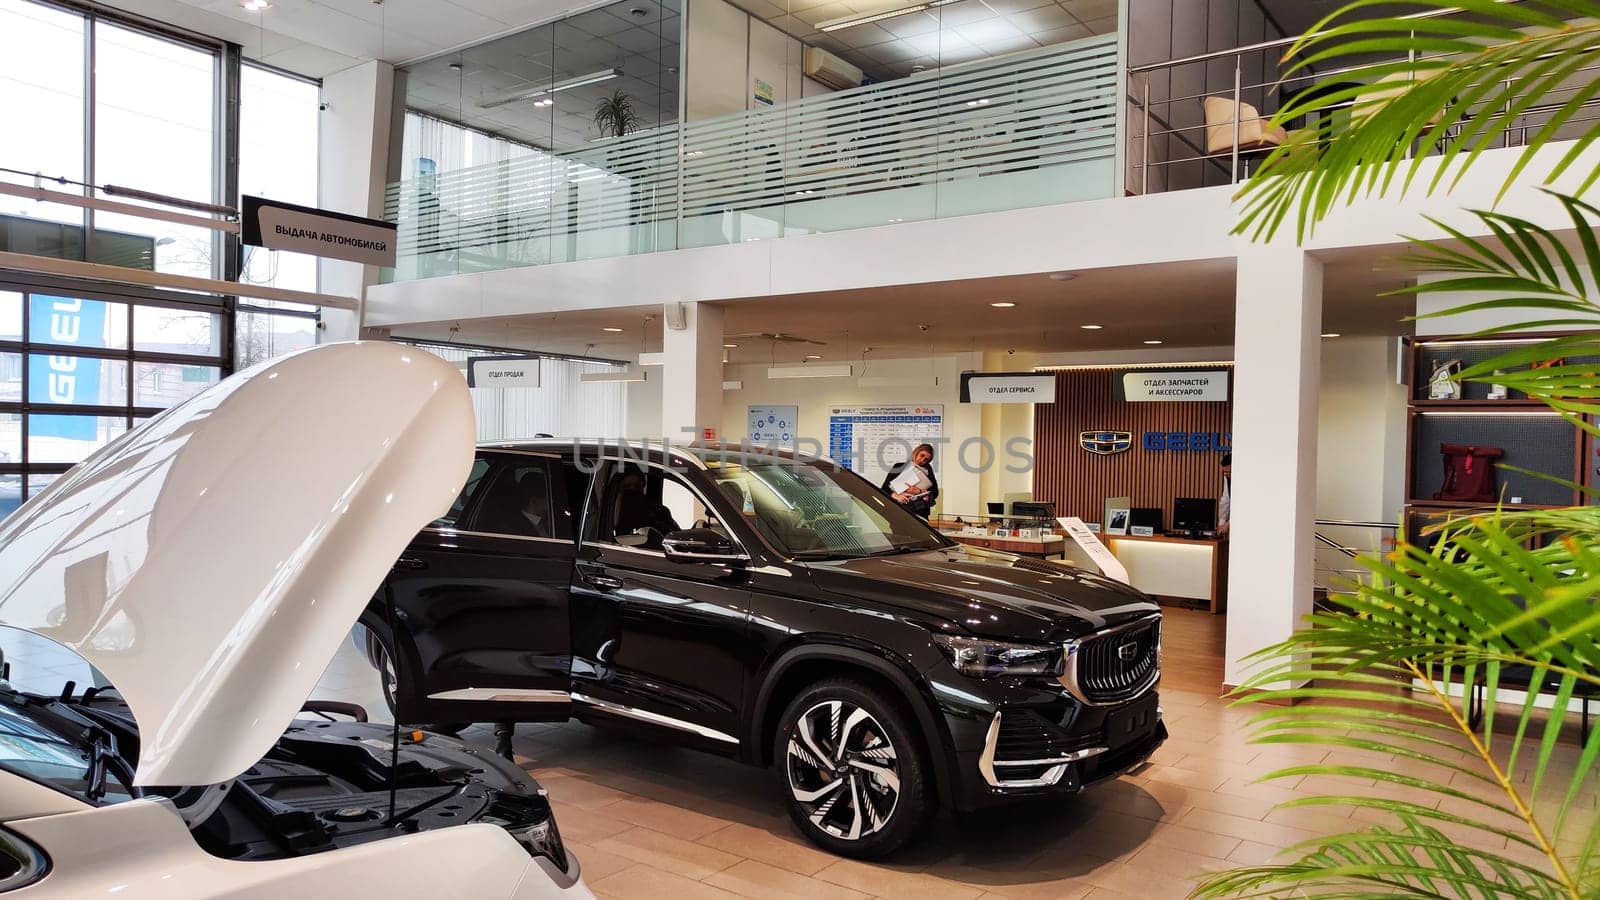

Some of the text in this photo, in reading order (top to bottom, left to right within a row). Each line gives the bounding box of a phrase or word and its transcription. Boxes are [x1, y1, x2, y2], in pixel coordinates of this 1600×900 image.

[275, 224, 387, 252] ВЫДАЧА АВТОМОБИЛЕЙ
[1144, 377, 1209, 387] ОТДЕЛ ЗАПЧАСТЕЙ
[989, 386, 1035, 394] ОТДЕЛ СЕРВИСА
